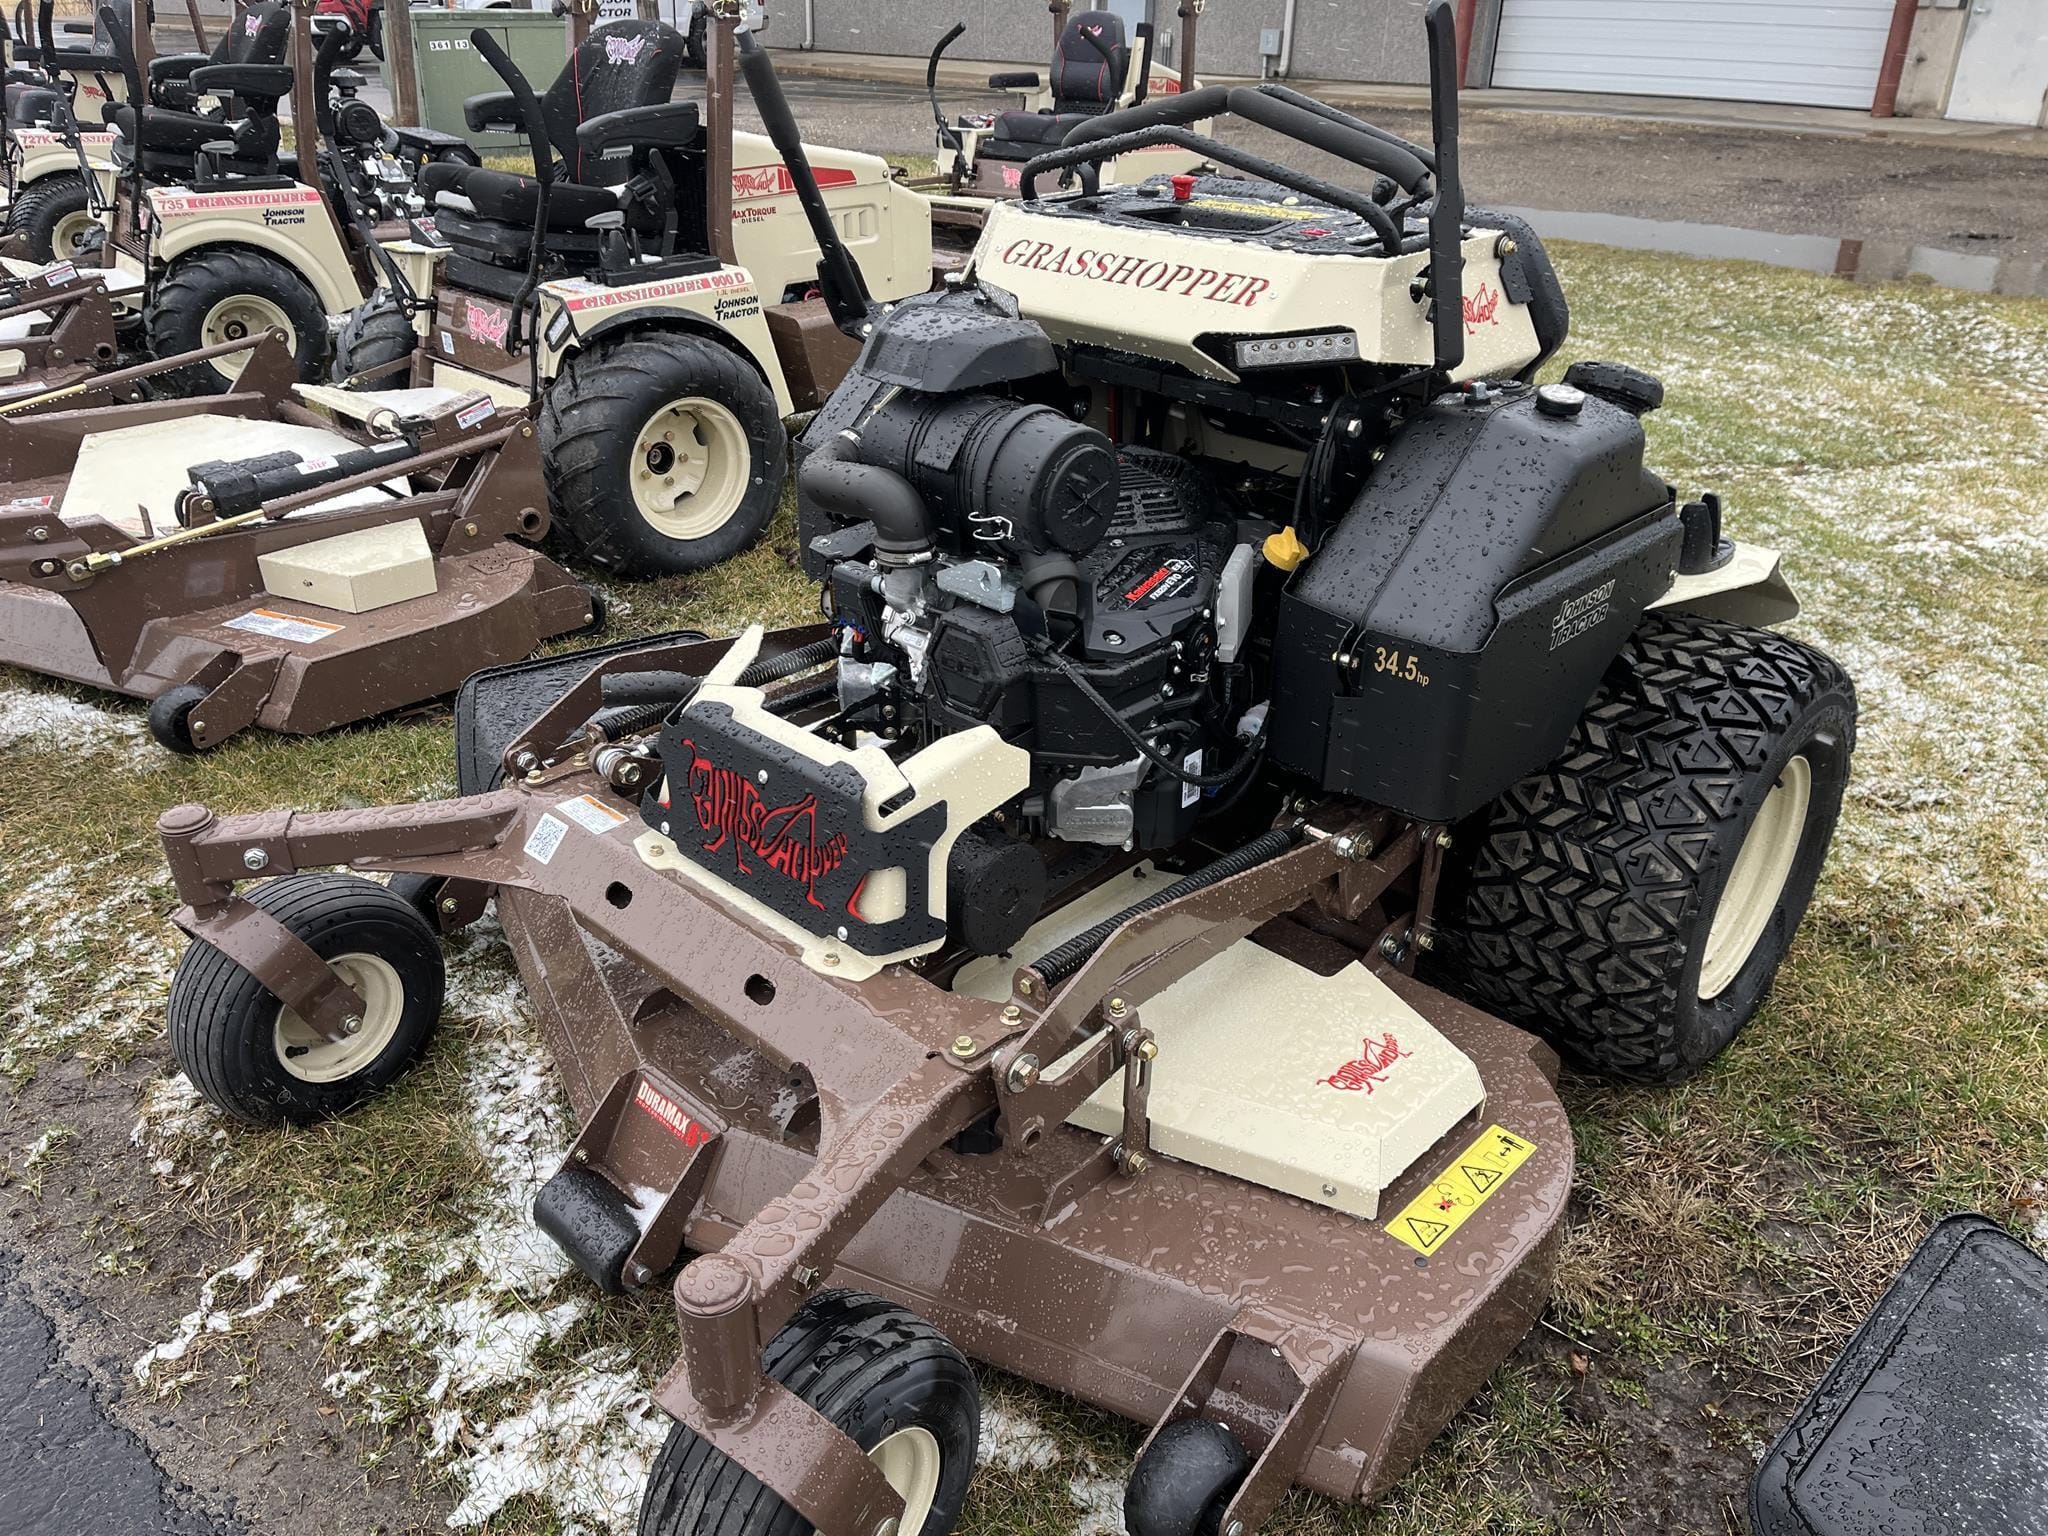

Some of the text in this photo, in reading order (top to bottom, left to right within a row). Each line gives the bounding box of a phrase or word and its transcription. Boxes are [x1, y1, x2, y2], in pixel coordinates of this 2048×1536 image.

[158, 192, 308, 211] 735 GRASSHOPPER
[262, 208, 305, 217] JOHNSON
[264, 217, 305, 226] TRACTOR
[1002, 239, 1270, 307] GRASSHOPPER
[582, 277, 705, 309] GRASSHOPPER
[711, 274, 734, 287] 900
[734, 272, 745, 283] D
[714, 295, 758, 310] JOHNSON
[715, 306, 759, 321] TRACTOR
[1552, 578, 1616, 628] JOHNSON
[1550, 603, 1609, 651] TRACTOR
[1374, 646, 1430, 687] 34.5 hp
